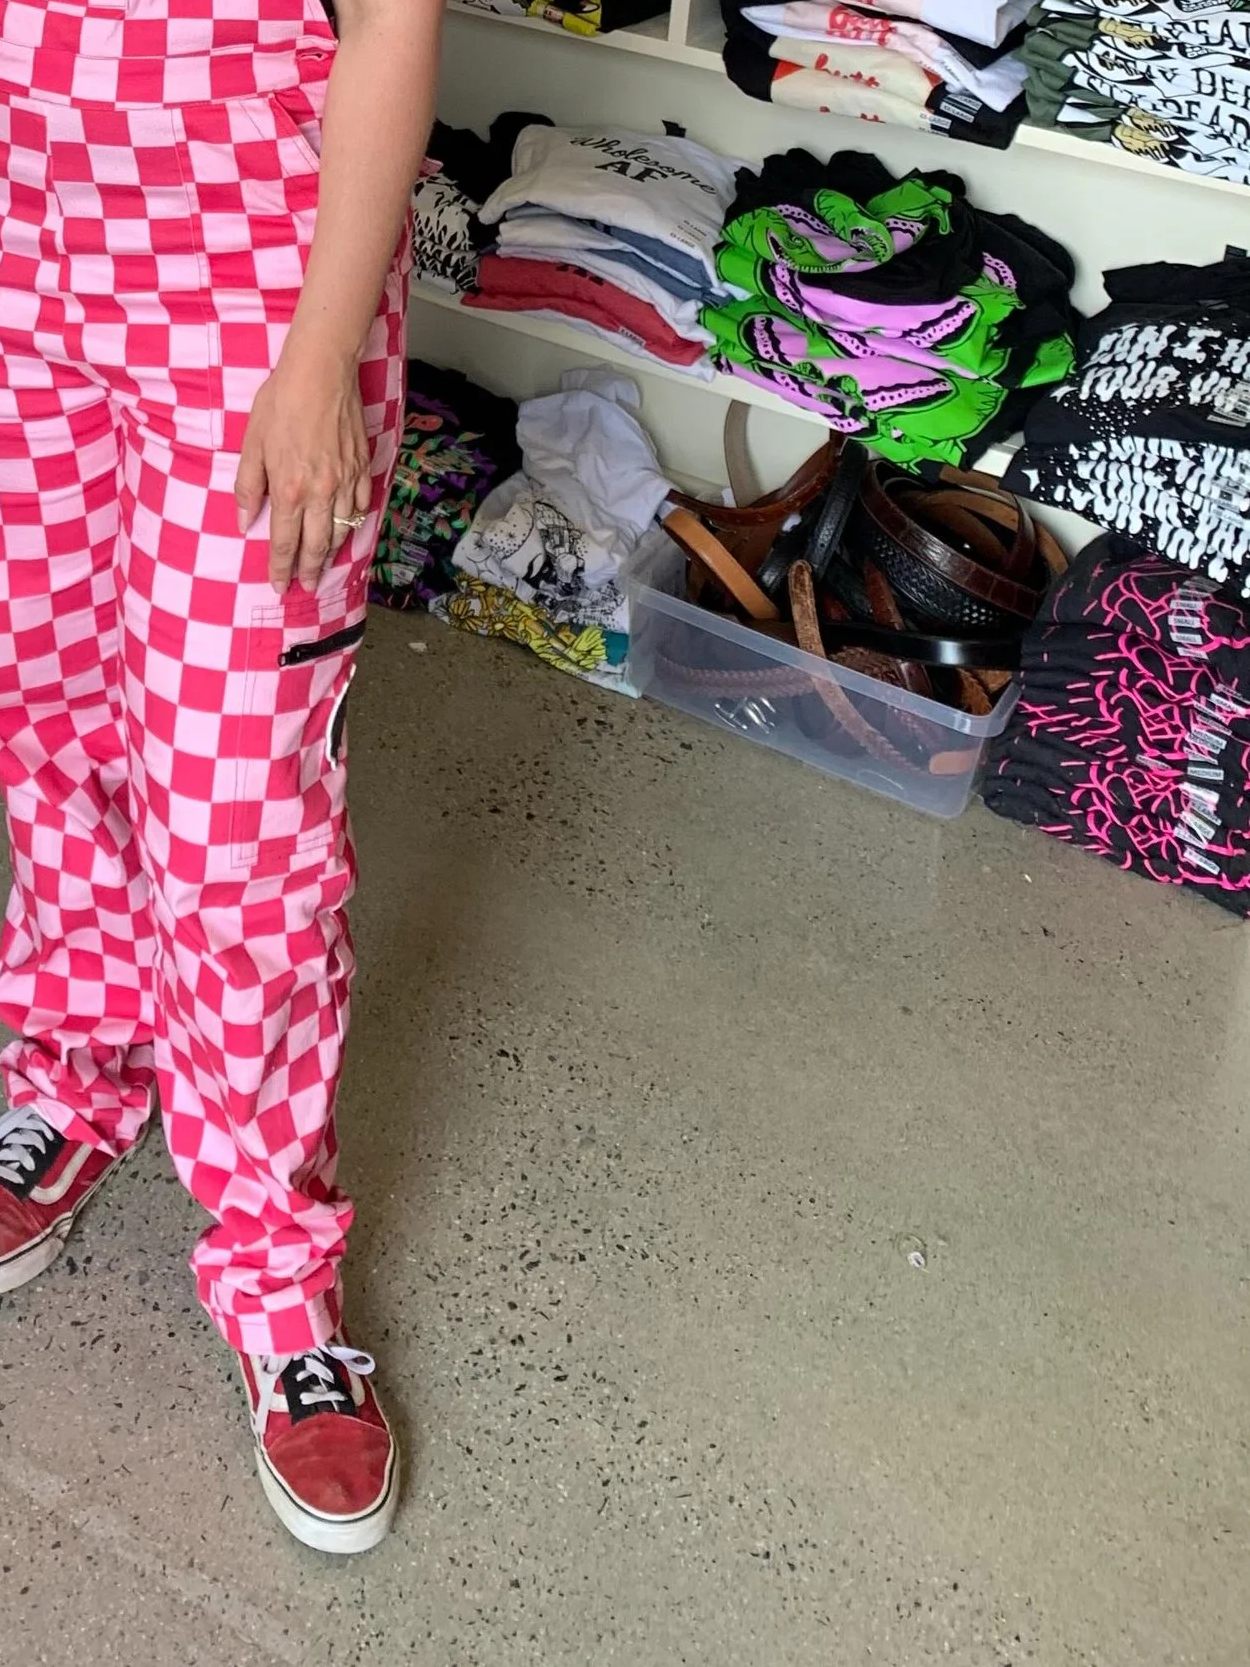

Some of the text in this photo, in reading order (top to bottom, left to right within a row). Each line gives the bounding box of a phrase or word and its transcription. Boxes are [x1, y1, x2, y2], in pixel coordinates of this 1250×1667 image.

[569, 135, 717, 195] Wholesome
[595, 160, 668, 183] AF
[1190, 769, 1222, 778] MEDIUM
